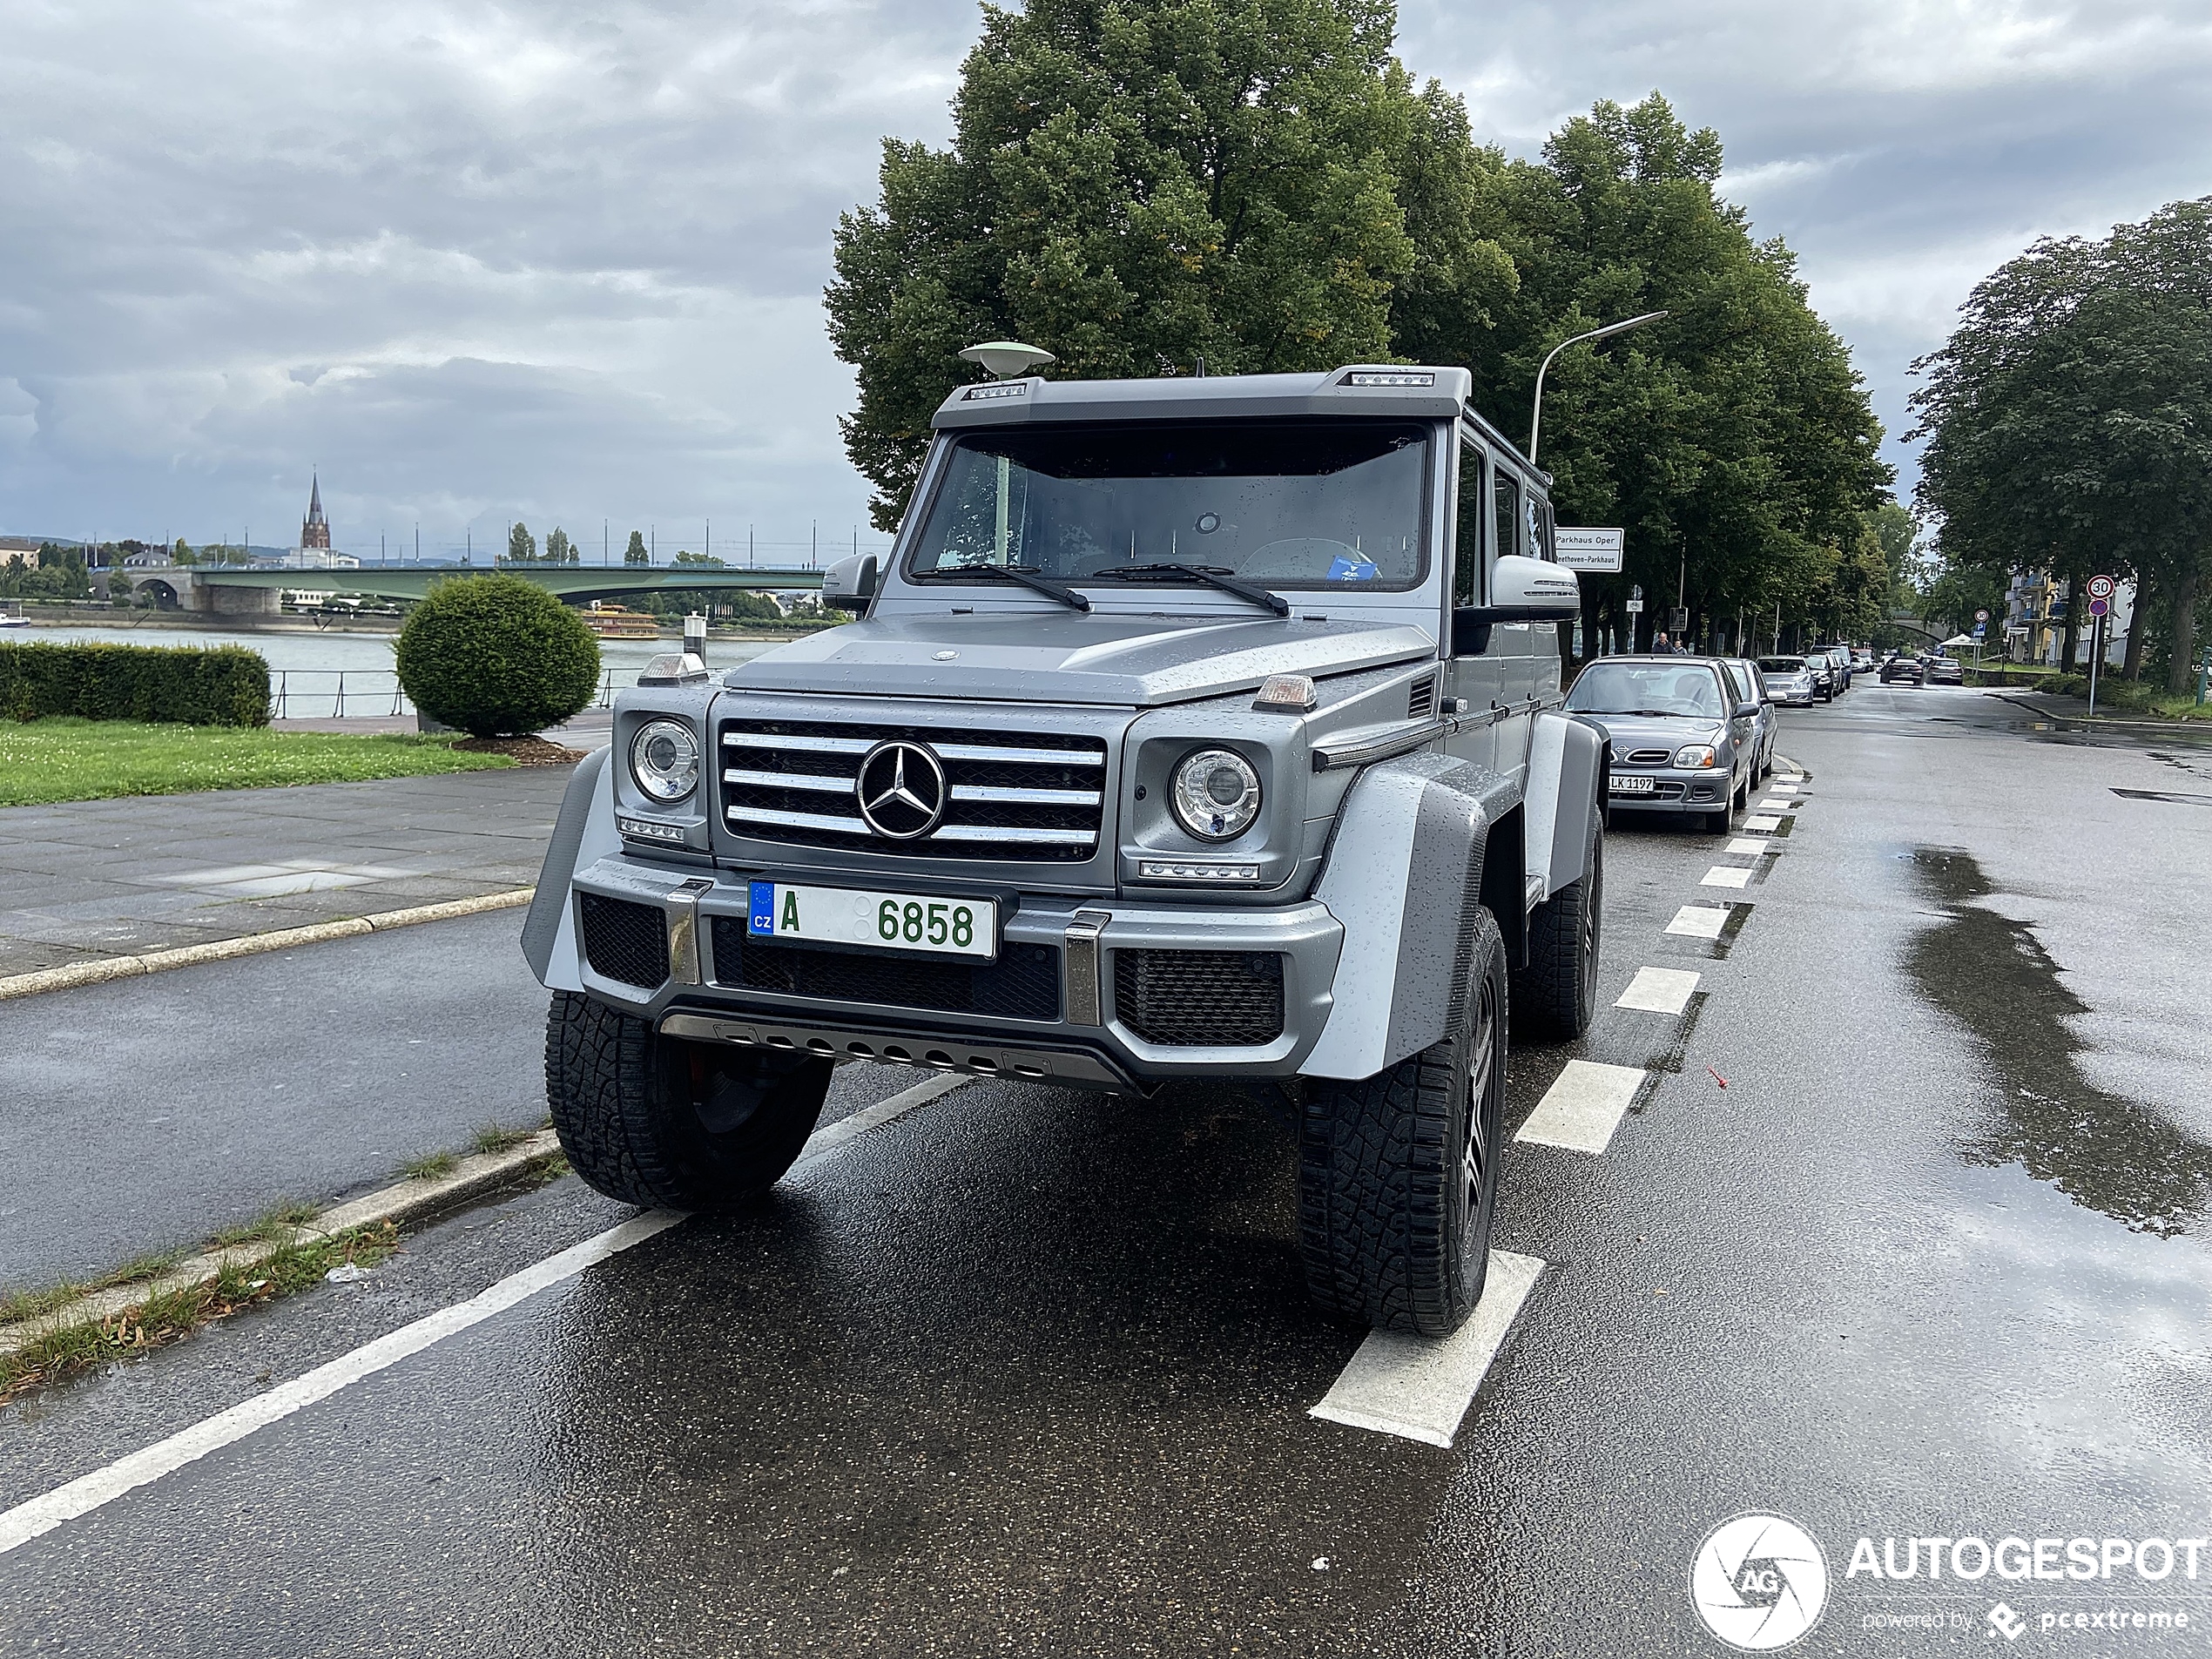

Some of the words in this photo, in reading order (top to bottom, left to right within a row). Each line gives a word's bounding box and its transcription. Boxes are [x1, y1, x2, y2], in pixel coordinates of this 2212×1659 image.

[1595, 536, 1615, 545] Oper
[1556, 555, 1615, 563] eethoven-Parkhaus
[2093, 582, 2108, 592] 30
[1611, 777, 1624, 789] LK
[1626, 778, 1653, 789] 1197
[754, 915, 772, 928] CZ
[780, 890, 800, 932] A
[878, 899, 974, 948] 6858
